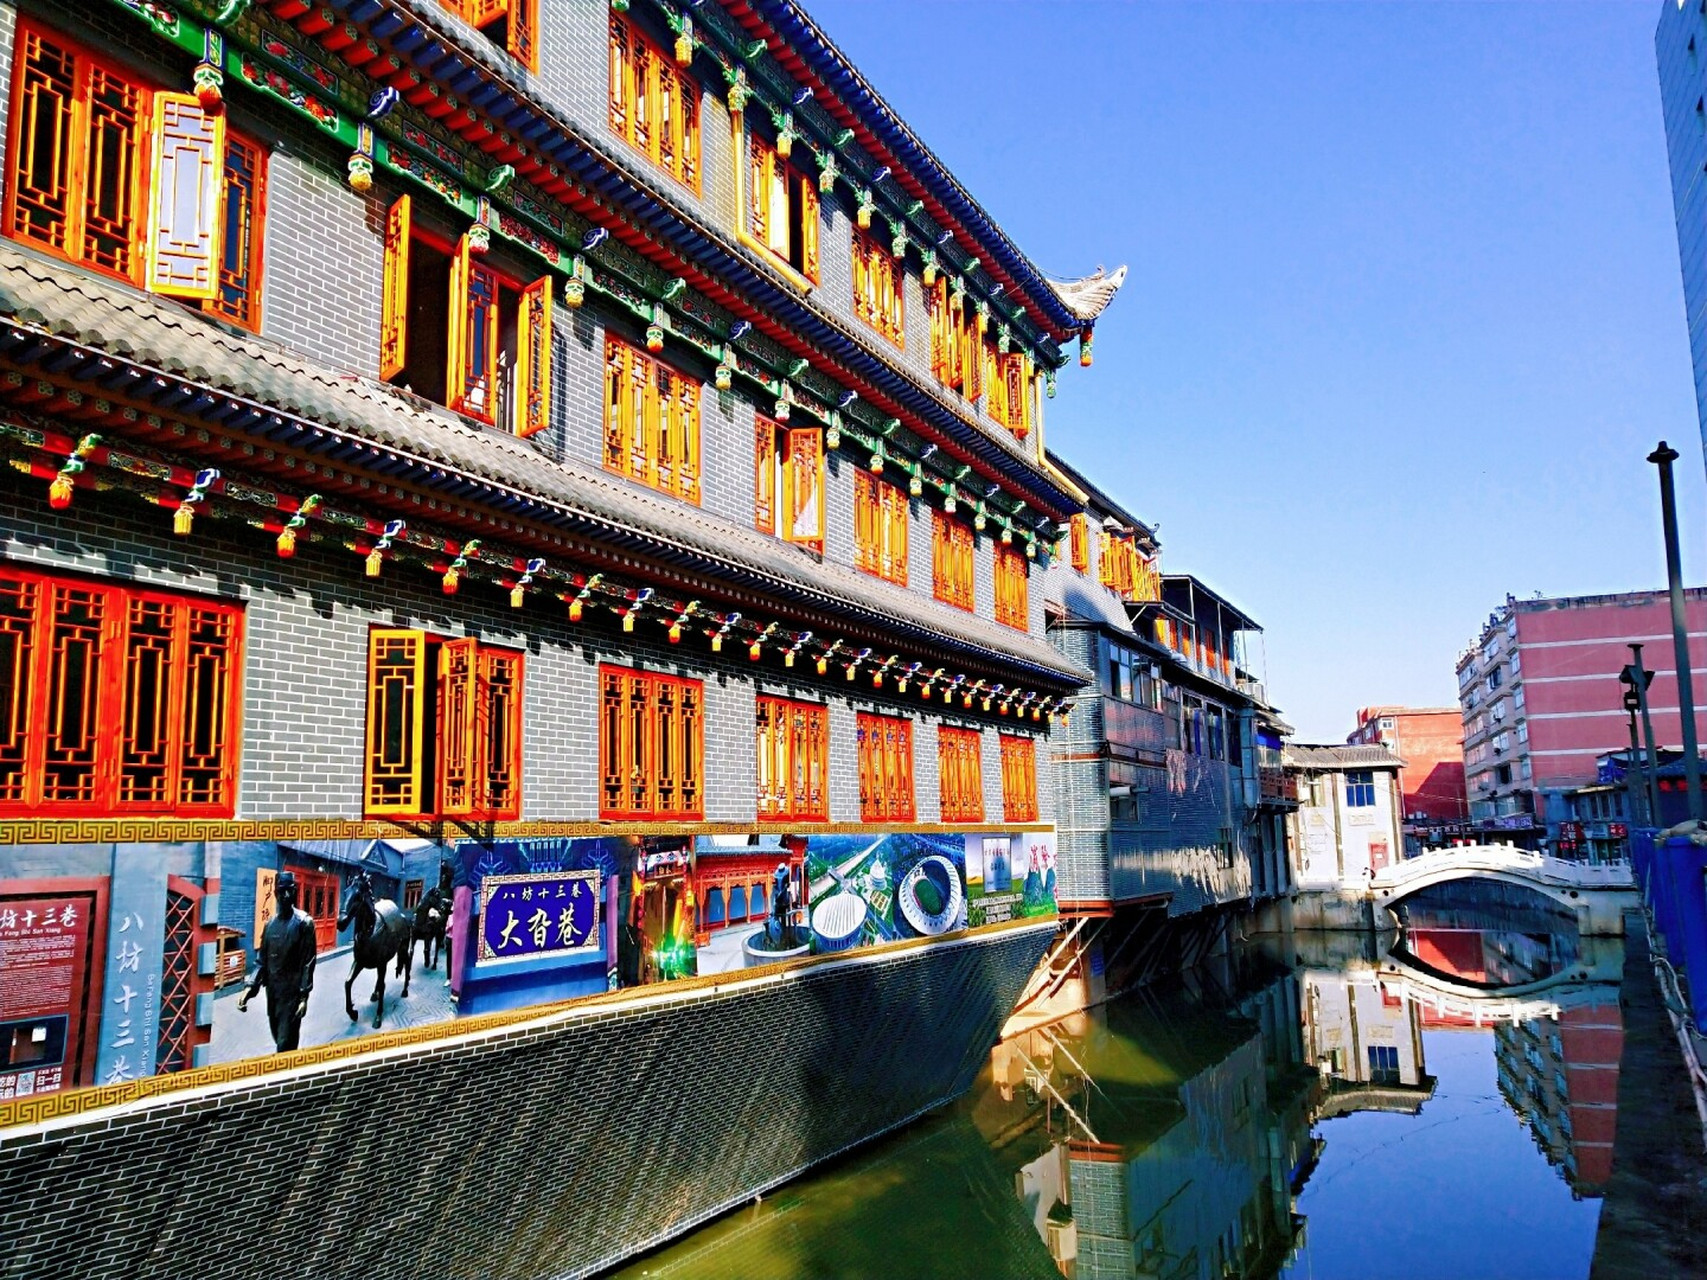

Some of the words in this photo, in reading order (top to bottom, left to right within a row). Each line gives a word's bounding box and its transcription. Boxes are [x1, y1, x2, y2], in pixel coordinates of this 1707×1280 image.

[503, 881, 582, 901] 八坊十三巷
[0, 903, 78, 929] 坊十三巷
[105, 911, 144, 1084] 八坊十三巷
